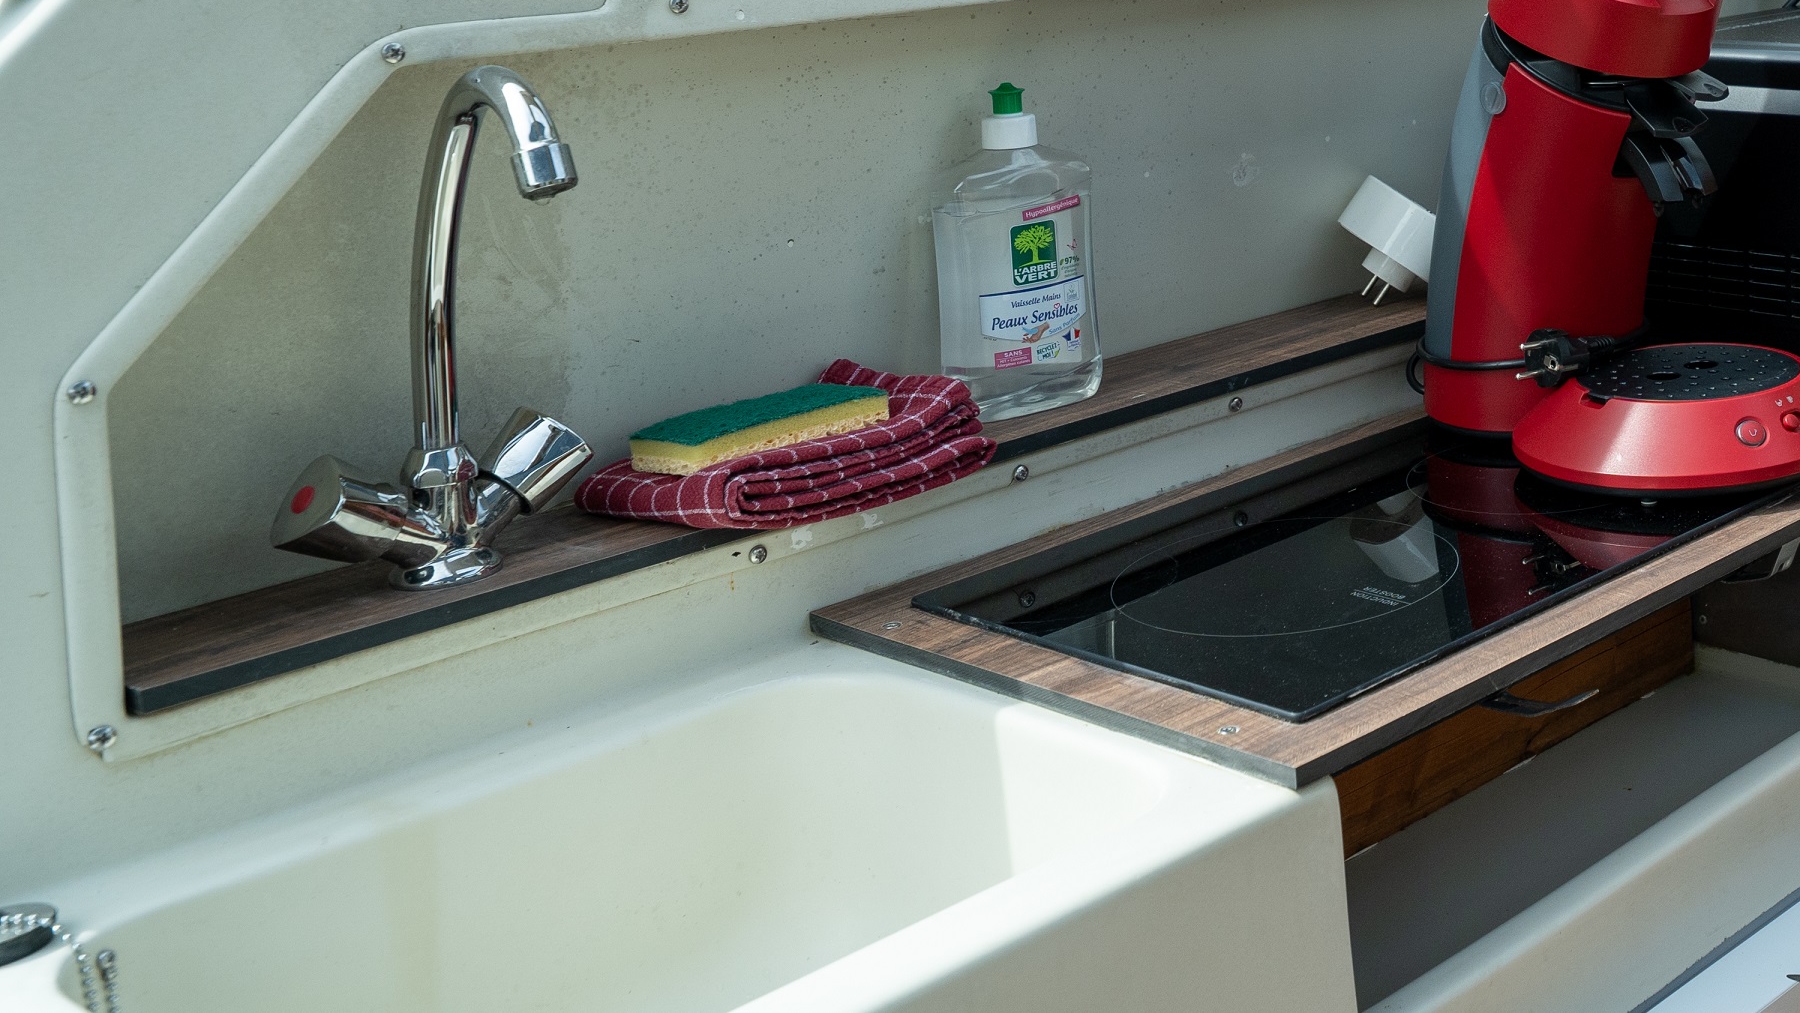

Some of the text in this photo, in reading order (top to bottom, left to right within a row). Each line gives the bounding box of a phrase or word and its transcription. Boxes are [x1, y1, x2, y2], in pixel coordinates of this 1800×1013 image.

[1014, 261, 1057, 276] L'ARBRE
[1014, 268, 1057, 284] VERT
[1011, 297, 1041, 309] Vaisselle
[1041, 292, 1062, 303] Mains
[991, 303, 1078, 331] Peaux Sensibles
[1004, 350, 1023, 358] SANS
[1350, 591, 1400, 606] INDUCTION
[1363, 586, 1406, 600] BOOSTER
